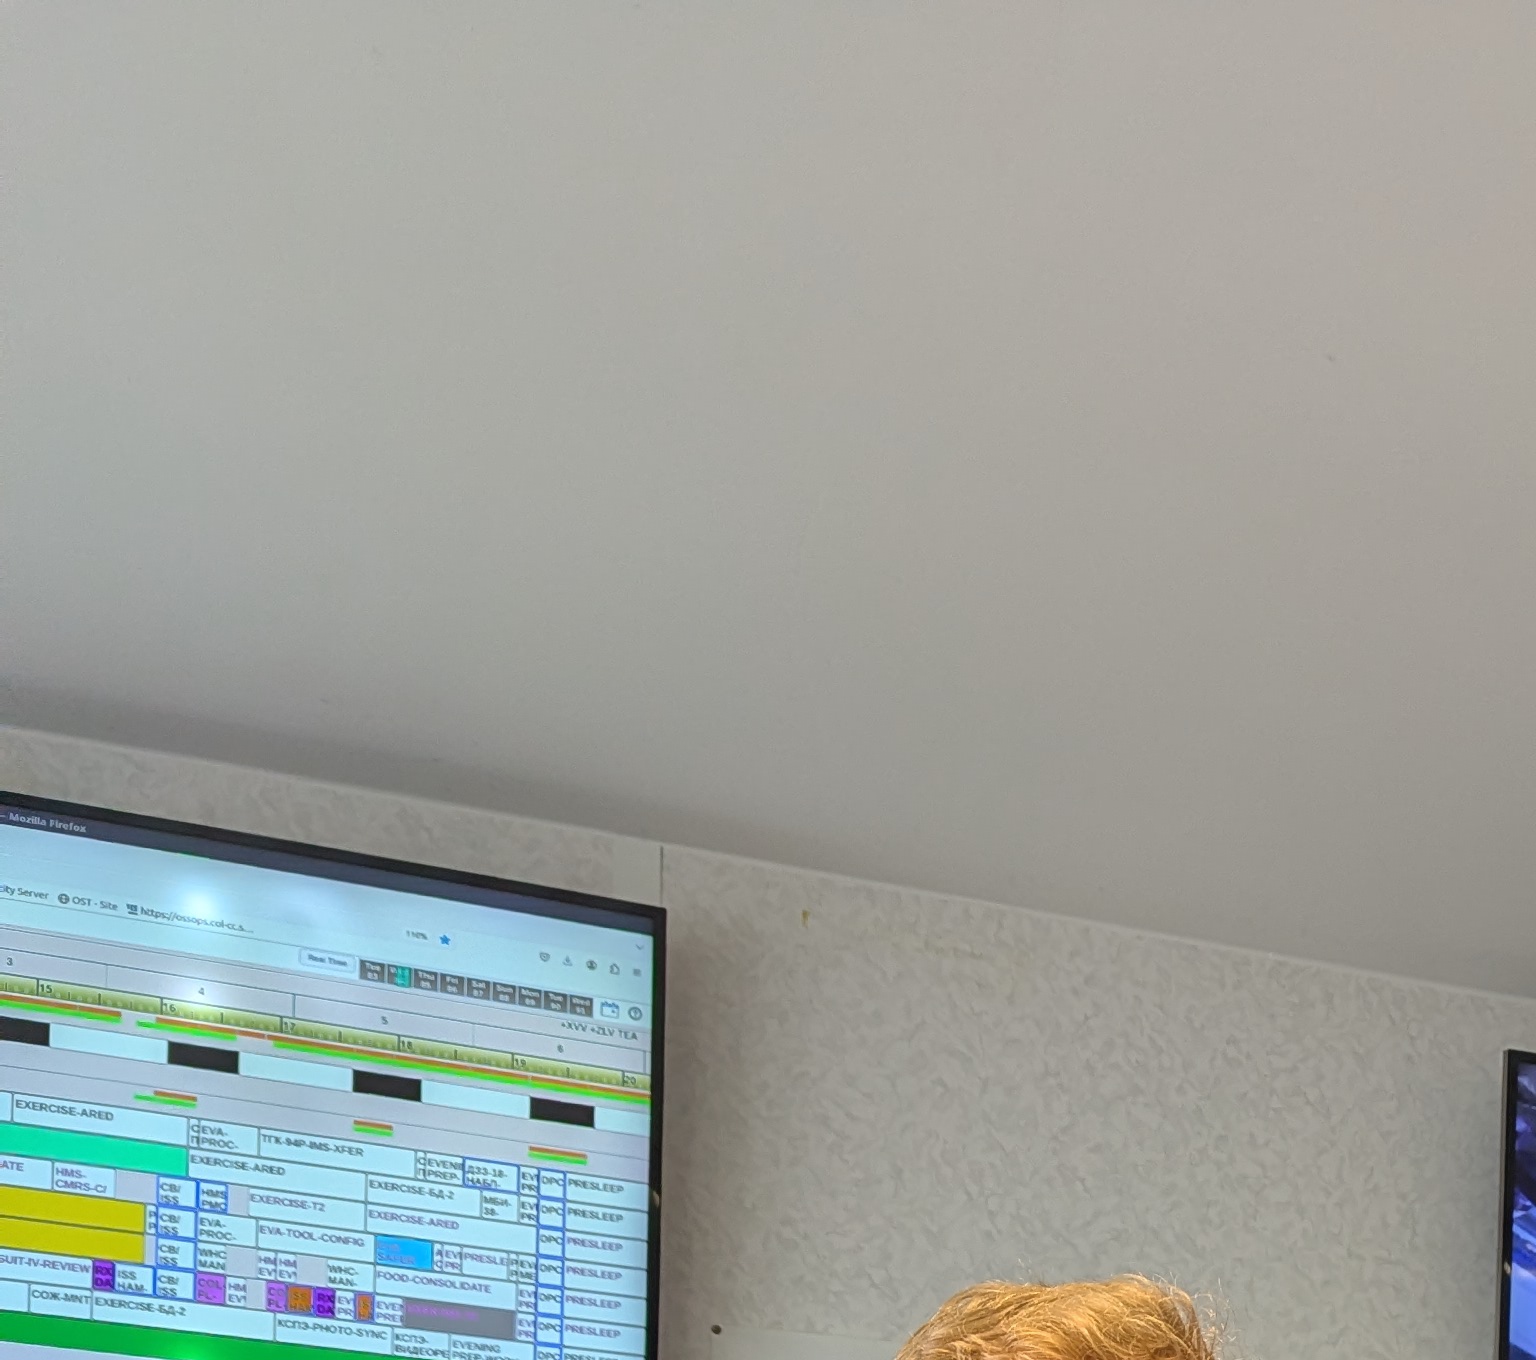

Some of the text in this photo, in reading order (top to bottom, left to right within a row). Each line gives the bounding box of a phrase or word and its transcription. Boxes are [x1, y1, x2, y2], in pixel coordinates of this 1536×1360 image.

[9, 812, 87, 833] Mozilla Firefox
[17, 886, 50, 900] Server
[72, 895, 92, 908] OST
[15, 1099, 114, 1122] EXERCISE-ARED
[190, 1153, 286, 1176] EXERCISE-ARED
[567, 1178, 625, 1194] PRESLEEP
[250, 1193, 326, 1213] EXERCISE-T2
[368, 1208, 460, 1231] EXERCISE-ARED
[567, 1207, 624, 1223] PRESLEEP
[259, 1225, 366, 1248] EVA-TOOL-CONFIG
[566, 1235, 624, 1252] PRESLEEP
[566, 1264, 622, 1281] PRESLEEP
[376, 1270, 492, 1294] FOOD-CONSOLIDATE
[565, 1294, 622, 1310] PRESLEEP
[564, 1323, 621, 1339] PRESLEEP
[451, 1339, 501, 1353] EVENING
